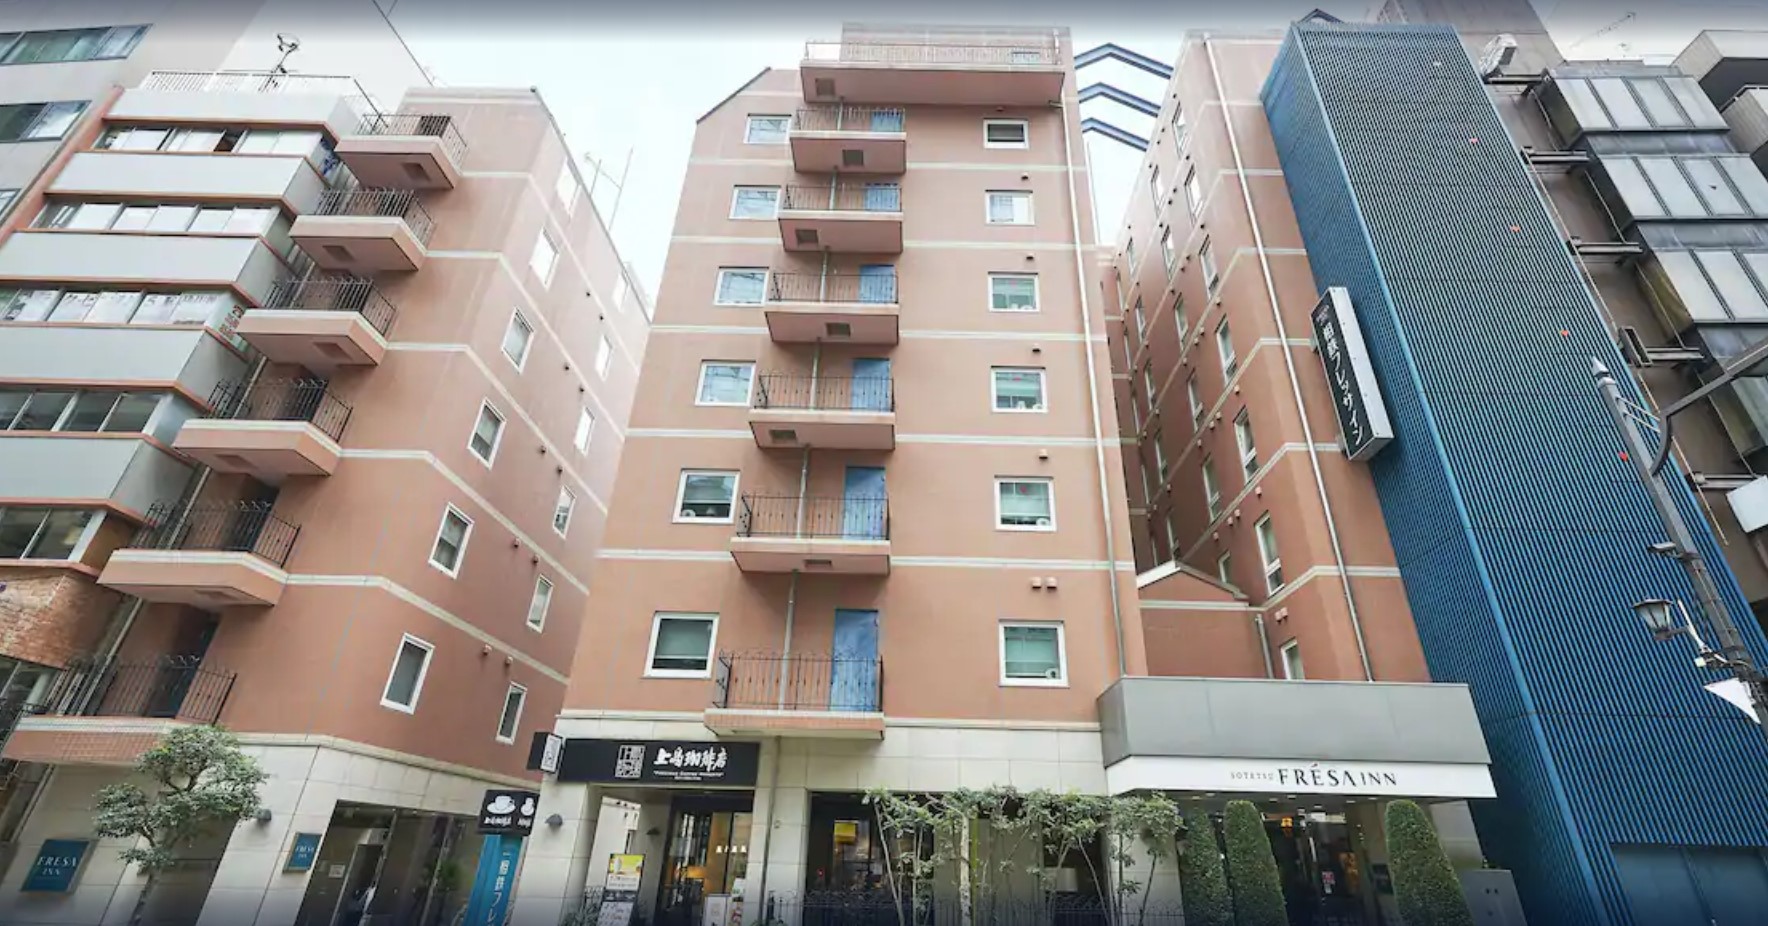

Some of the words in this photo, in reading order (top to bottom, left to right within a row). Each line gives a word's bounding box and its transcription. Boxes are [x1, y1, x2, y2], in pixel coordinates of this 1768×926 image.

[653, 746, 728, 772] 上島珈琲店
[1360, 771, 1397, 787] INN
